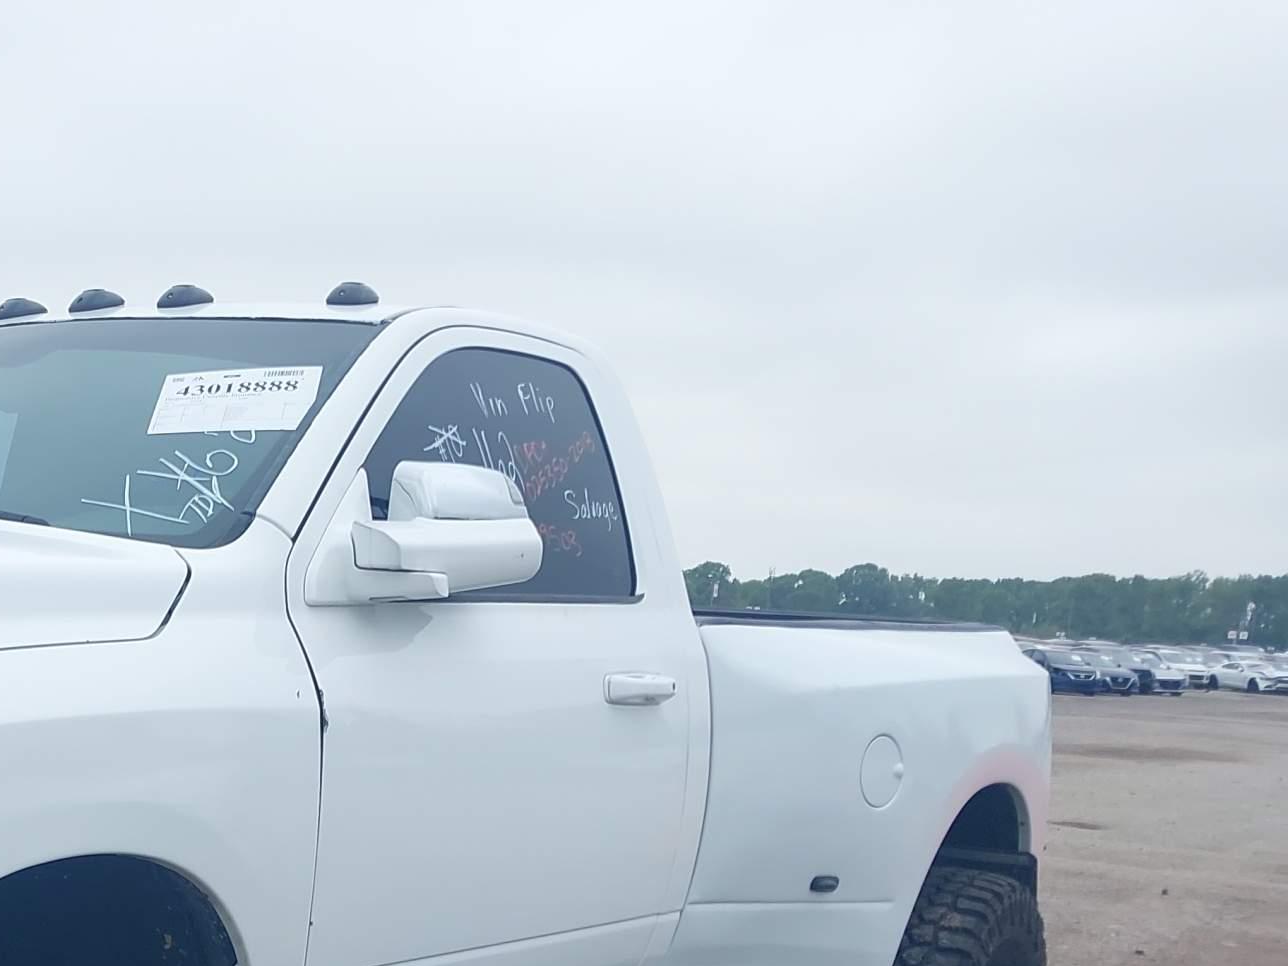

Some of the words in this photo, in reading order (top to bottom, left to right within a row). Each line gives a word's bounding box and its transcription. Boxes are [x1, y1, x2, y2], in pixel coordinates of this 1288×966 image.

[175, 380, 299, 396] 43018888
[469, 383, 509, 418] Vin
[517, 382, 555, 424] Flip
[562, 487, 618, 532] Salvage
